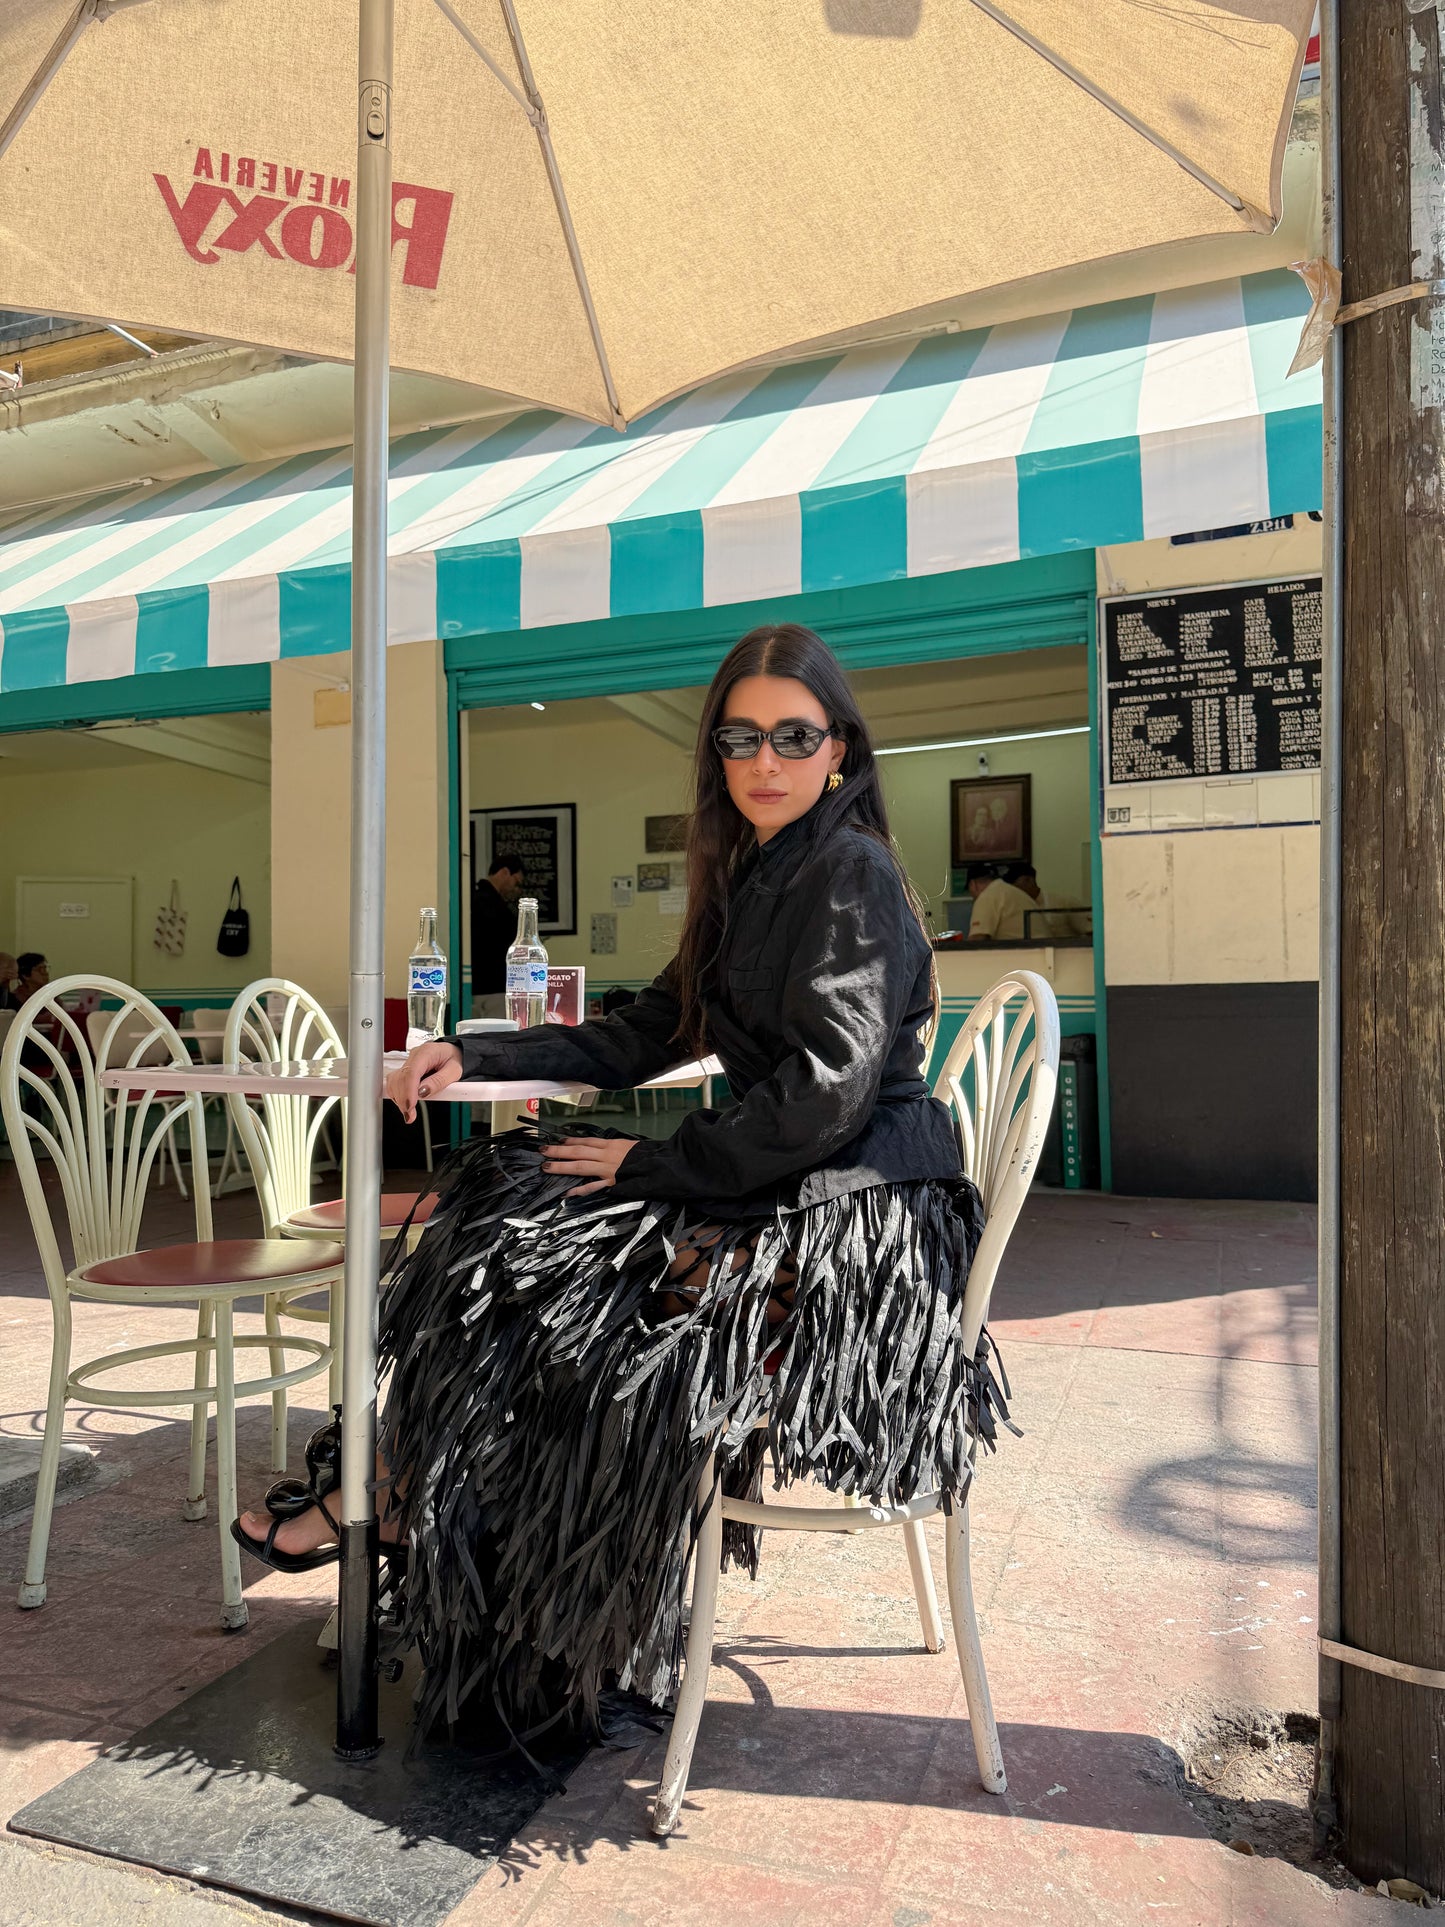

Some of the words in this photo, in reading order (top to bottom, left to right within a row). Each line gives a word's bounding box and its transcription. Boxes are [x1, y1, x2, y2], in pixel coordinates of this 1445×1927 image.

[1267, 583, 1305, 594] HELADOS
[1244, 598, 1265, 606] CAFE
[1117, 612, 1143, 621] LIMON
[1184, 609, 1231, 621] MANDARINA
[1117, 620, 1143, 628] FRESA
[1184, 619, 1211, 627] MAMEY
[1245, 618, 1272, 627] MENTA
[1184, 625, 1214, 634] SANDIA
[1184, 632, 1212, 640] ZAPOTE
[1245, 632, 1272, 640] FRESA
[1118, 637, 1162, 648] TAMARINDO
[1186, 639, 1208, 647] TUNA
[1294, 640, 1317, 648] TUTTI
[1120, 644, 1166, 655] ZARZAMORA
[1186, 645, 1208, 654] LIMA
[1245, 644, 1278, 653] CAJETA
[1147, 649, 1175, 659] ZAPOTE
[1184, 650, 1229, 660] GUANABANA
[1245, 652, 1274, 660] MAMEY
[1244, 656, 1289, 667] CHOCOLATE
[1167, 665, 1177, 673] DE
[1180, 661, 1224, 672] TEMPORADA
[1253, 672, 1272, 680] MINI
[1120, 693, 1168, 704] PREPARADOS
[1181, 687, 1229, 698] MALTEADAS
[1279, 710, 1300, 718] COCA
[1146, 714, 1179, 724] CHAMOY
[1147, 722, 1184, 731] ESPECIAL
[1280, 724, 1302, 732] AGUA
[1147, 729, 1178, 737] MARIAS
[1280, 729, 1319, 739] ESPRESSO
[1113, 738, 1144, 747] BANANA
[1112, 750, 1162, 760] MALTEADAS
[1281, 754, 1315, 763] CANASTA
[1112, 759, 1132, 767] COCA
[1134, 755, 1178, 766] FLOTANTE
[1114, 766, 1128, 774] ICE
[1134, 764, 1160, 772] CREAM
[1064, 1076, 1075, 1177] ORGANICOS
